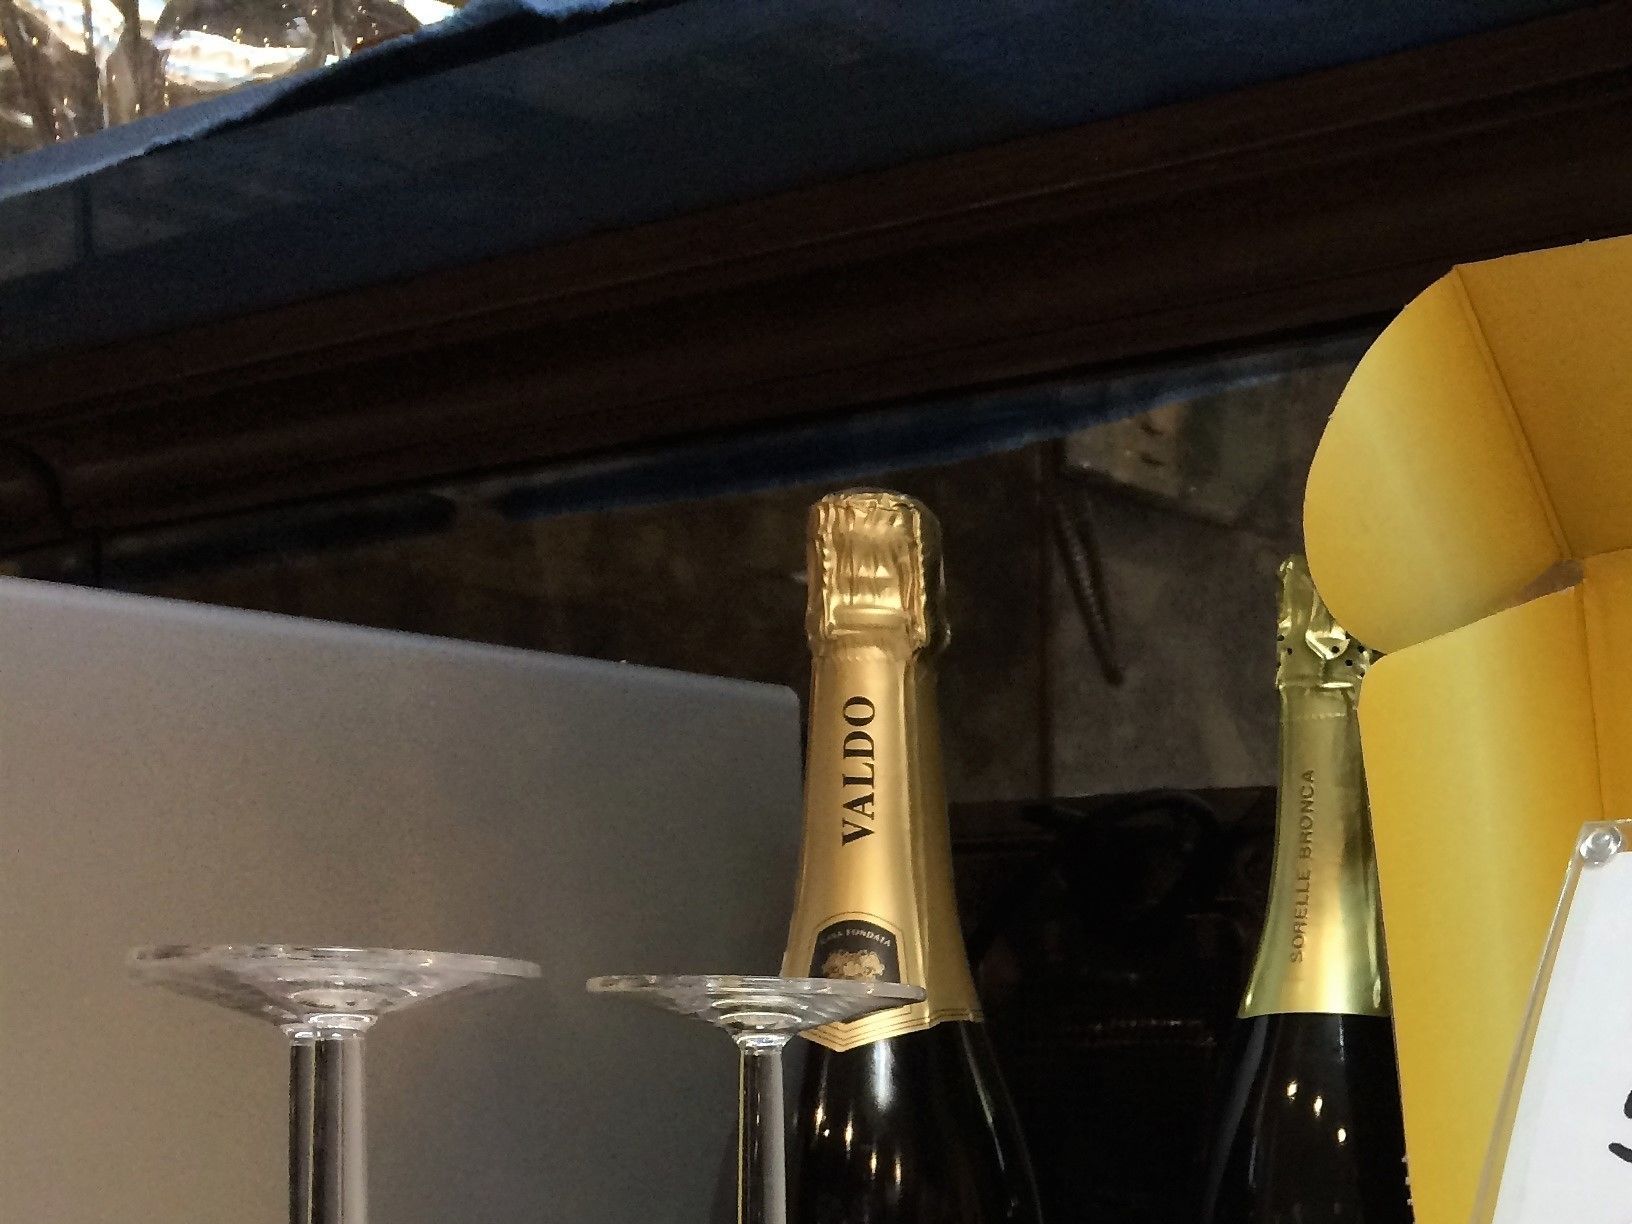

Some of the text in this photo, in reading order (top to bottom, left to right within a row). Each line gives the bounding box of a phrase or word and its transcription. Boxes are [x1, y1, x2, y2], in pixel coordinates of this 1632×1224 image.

[842, 696, 876, 847] VALDO
[1289, 770, 1315, 964] SORELLE BRONCA
